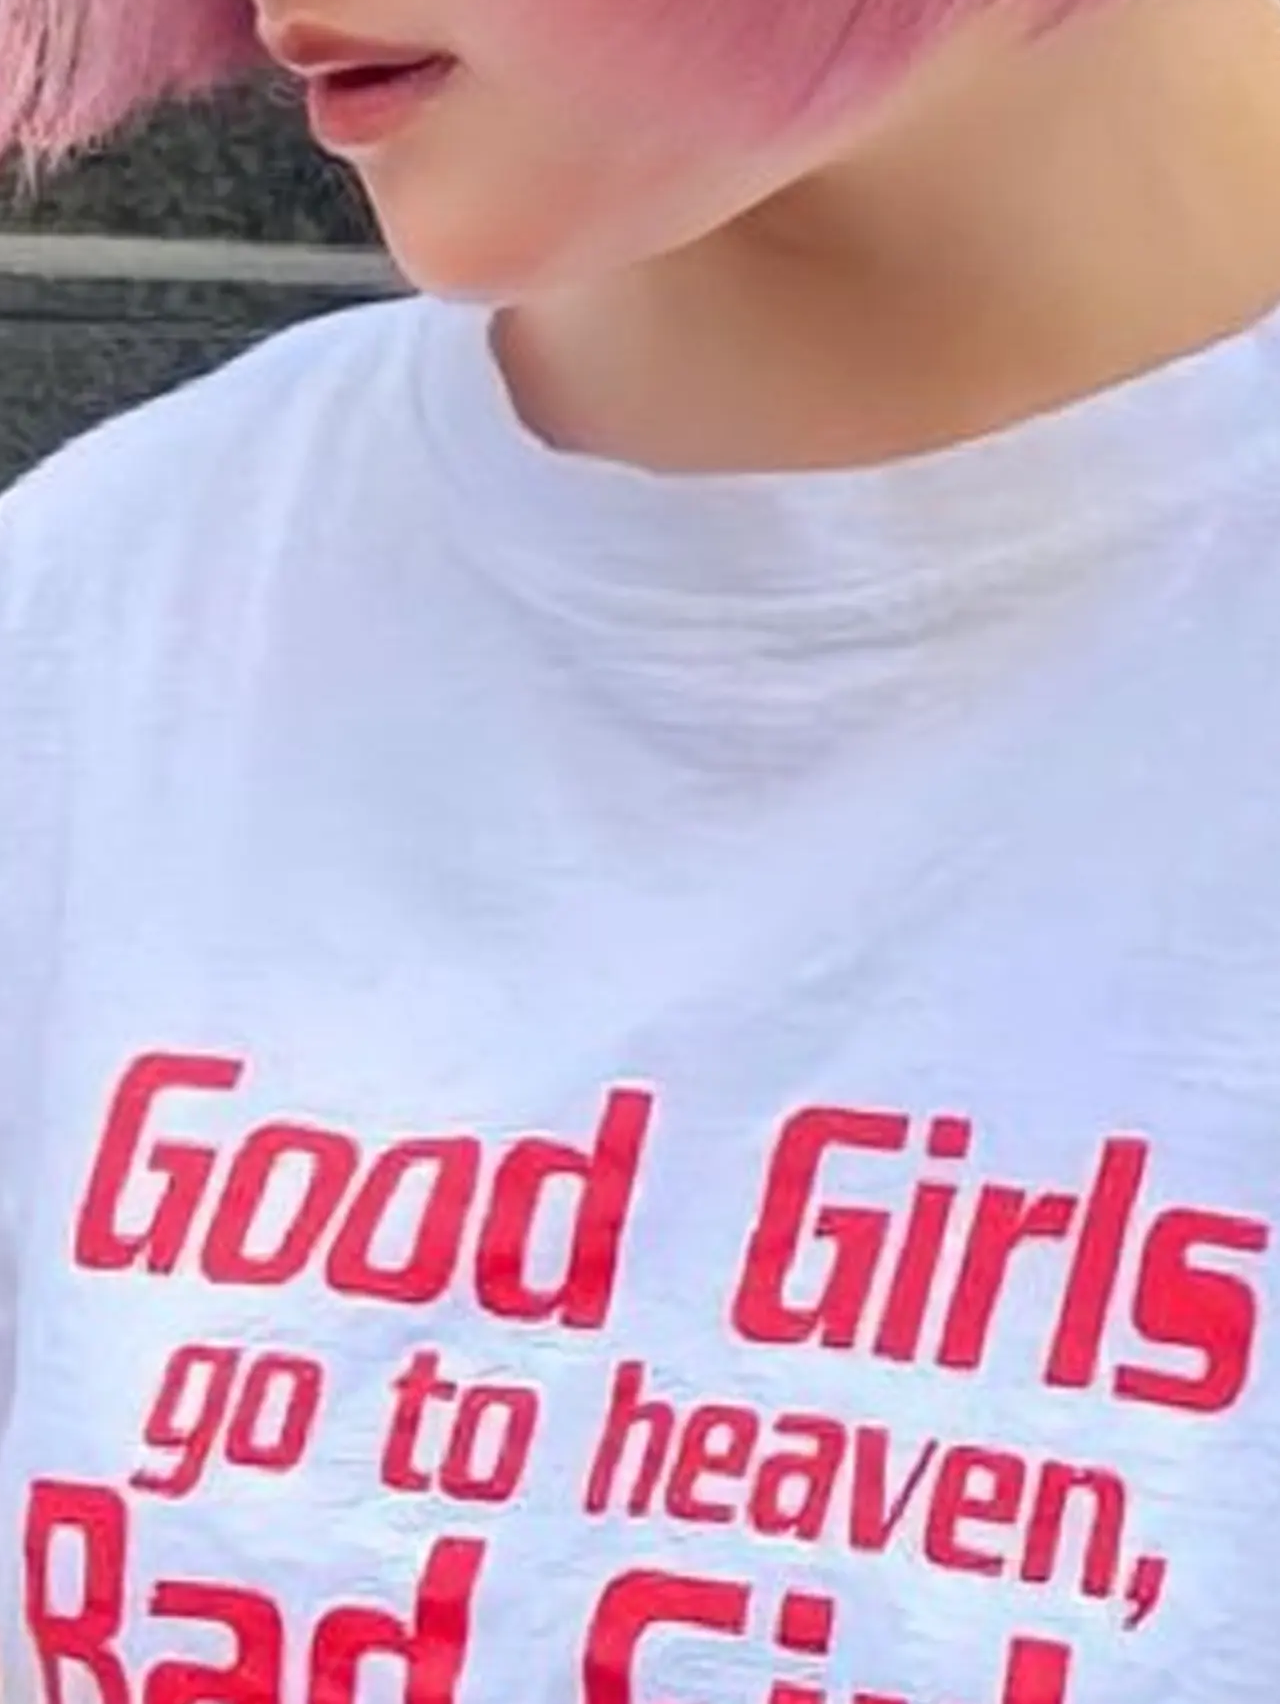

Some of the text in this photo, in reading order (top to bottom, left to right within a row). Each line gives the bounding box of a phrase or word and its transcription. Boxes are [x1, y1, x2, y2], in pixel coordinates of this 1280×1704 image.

[74, 1052, 1266, 1414] Good Girls
[128, 1343, 1167, 1628] go to heaven,
